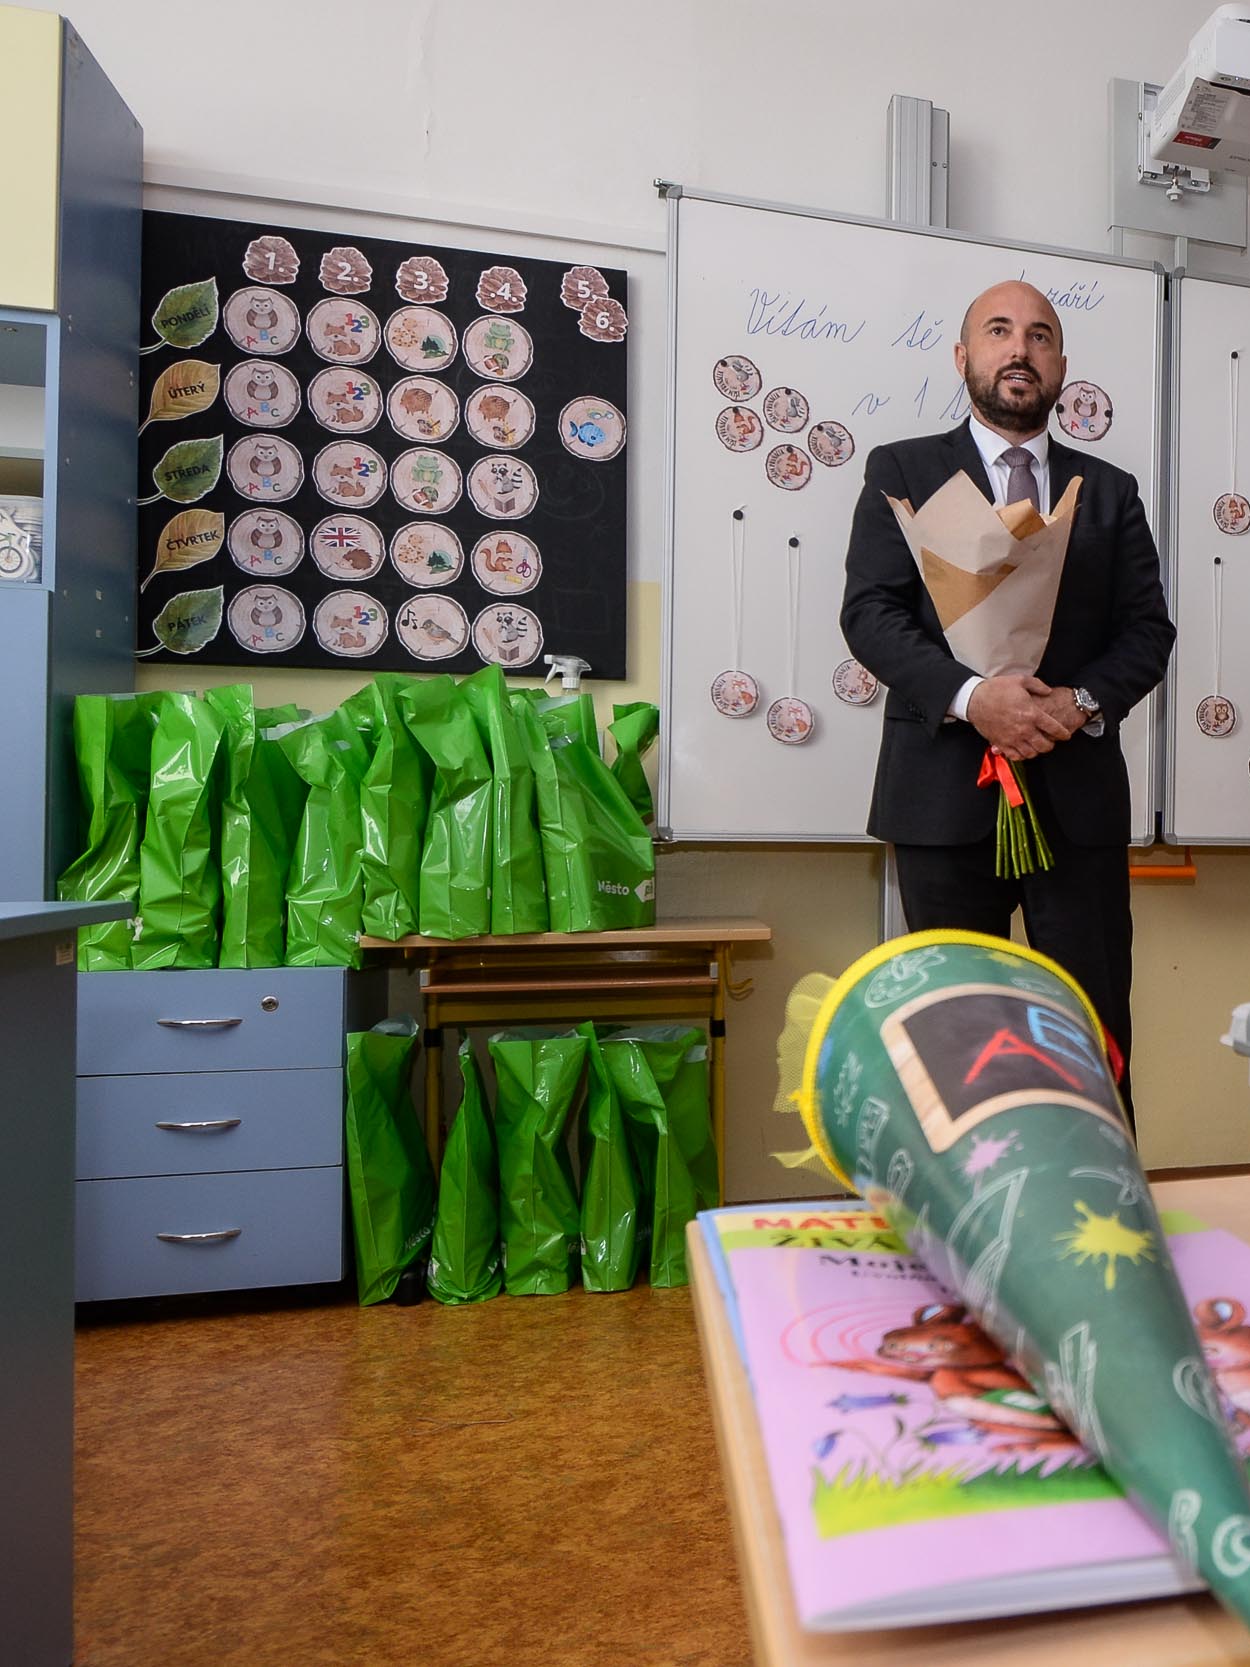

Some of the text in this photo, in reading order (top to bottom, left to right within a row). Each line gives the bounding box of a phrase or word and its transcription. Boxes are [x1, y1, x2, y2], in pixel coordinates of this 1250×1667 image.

[265, 251, 286, 273] 1.
[338, 261, 360, 283] 2.
[413, 272, 435, 292] 3.
[161, 304, 211, 328] PONDĚLÍ
[595, 311, 615, 332] 6.
[747, 288, 866, 343] Vítám
[891, 310, 944, 351] tě
[168, 380, 206, 400] ÚTERÝ
[851, 392, 891, 416] v
[164, 463, 211, 482] STŘEDA
[166, 530, 220, 551] ČTVRTEK
[168, 615, 207, 632] PÁTEK
[597, 879, 630, 896] Město
